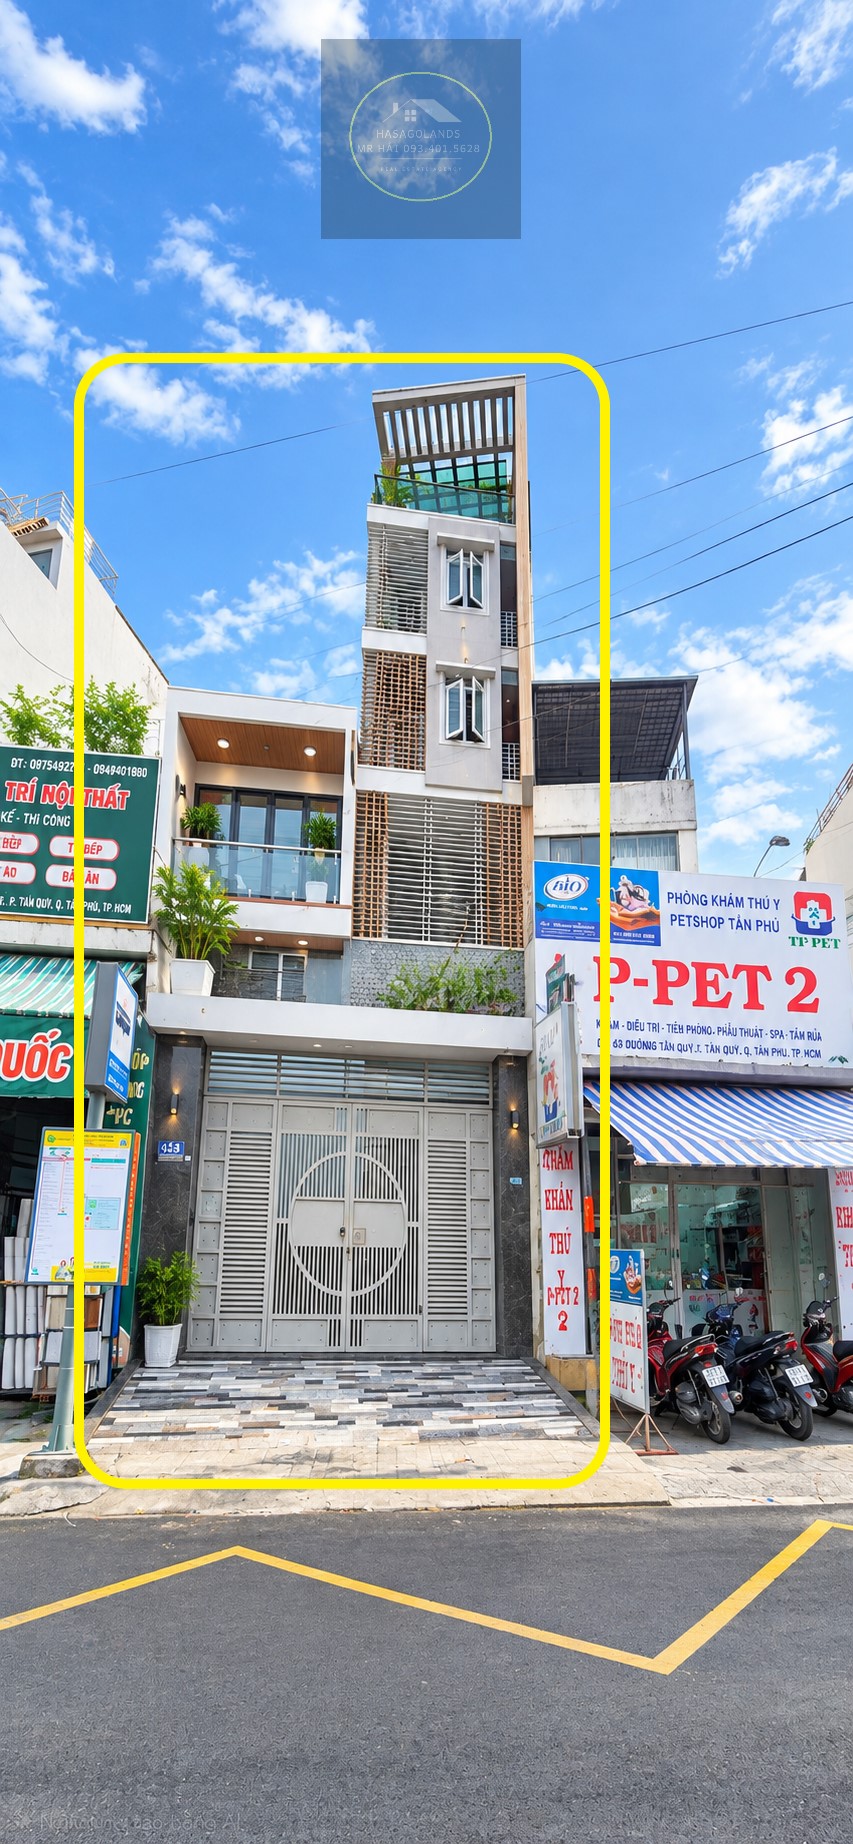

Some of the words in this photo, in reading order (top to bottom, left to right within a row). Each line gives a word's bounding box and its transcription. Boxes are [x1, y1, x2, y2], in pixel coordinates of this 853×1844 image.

[5, 776, 39, 803] TRÍ
[667, 891, 709, 907] PHÒNG
[711, 893, 745, 909] KHÁM
[747, 895, 771, 910] THÚ
[773, 898, 781, 911] Y
[670, 913, 725, 930] PETSHOP
[811, 937, 841, 950] PET
[593, 954, 773, 1011] P-PET
[784, 965, 820, 1014] 2
[0, 1028, 73, 1082] UỐC
[557, 1310, 569, 1331] 2
